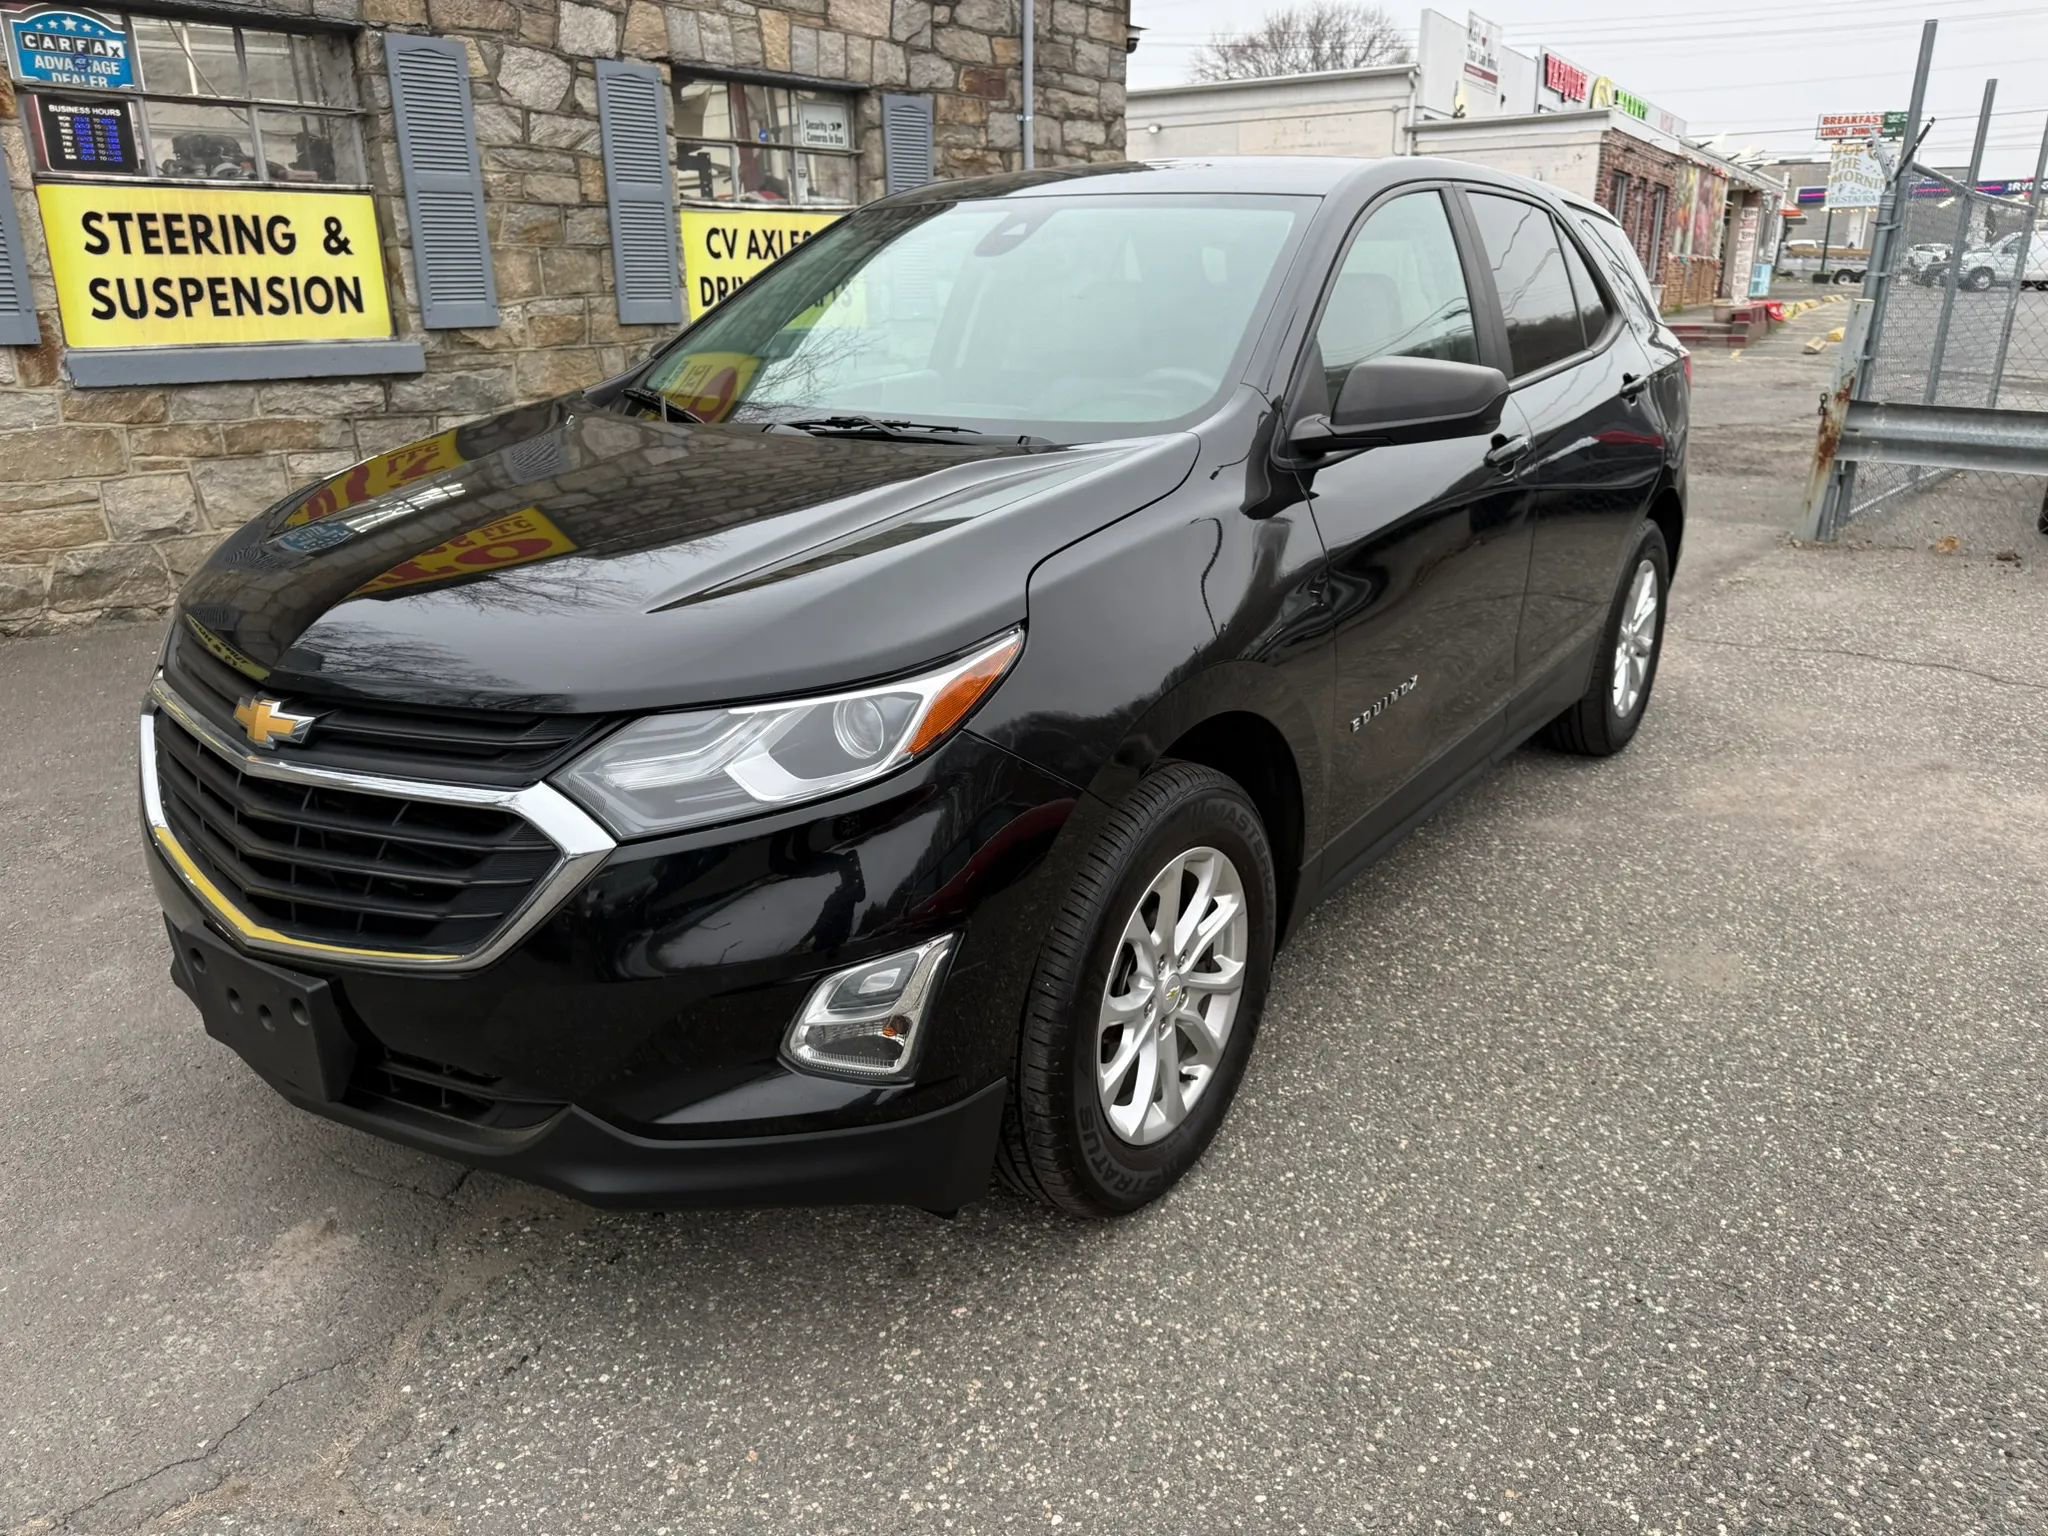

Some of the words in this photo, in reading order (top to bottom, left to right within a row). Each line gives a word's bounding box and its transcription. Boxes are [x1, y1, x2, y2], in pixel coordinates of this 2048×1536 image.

[24, 35, 122, 58] CARFAX
[35, 55, 121, 75] ADVAAGE
[51, 72, 108, 88] DEALER
[48, 104, 91, 115] BUSINESS
[92, 107, 121, 117] HOURS
[1823, 115, 1885, 126] BREAKFAST
[1821, 127, 1847, 136] LUNCH
[1852, 127, 1884, 136] DINR
[2006, 181, 2048, 192] IRVIG
[81, 211, 297, 257] STEERING
[322, 216, 353, 256] &
[706, 227, 738, 260] CV
[88, 276, 365, 320] SUSPENSION
[1350, 675, 1418, 733] EQUINOX
[1078, 1106, 1162, 1194] STRATUS
